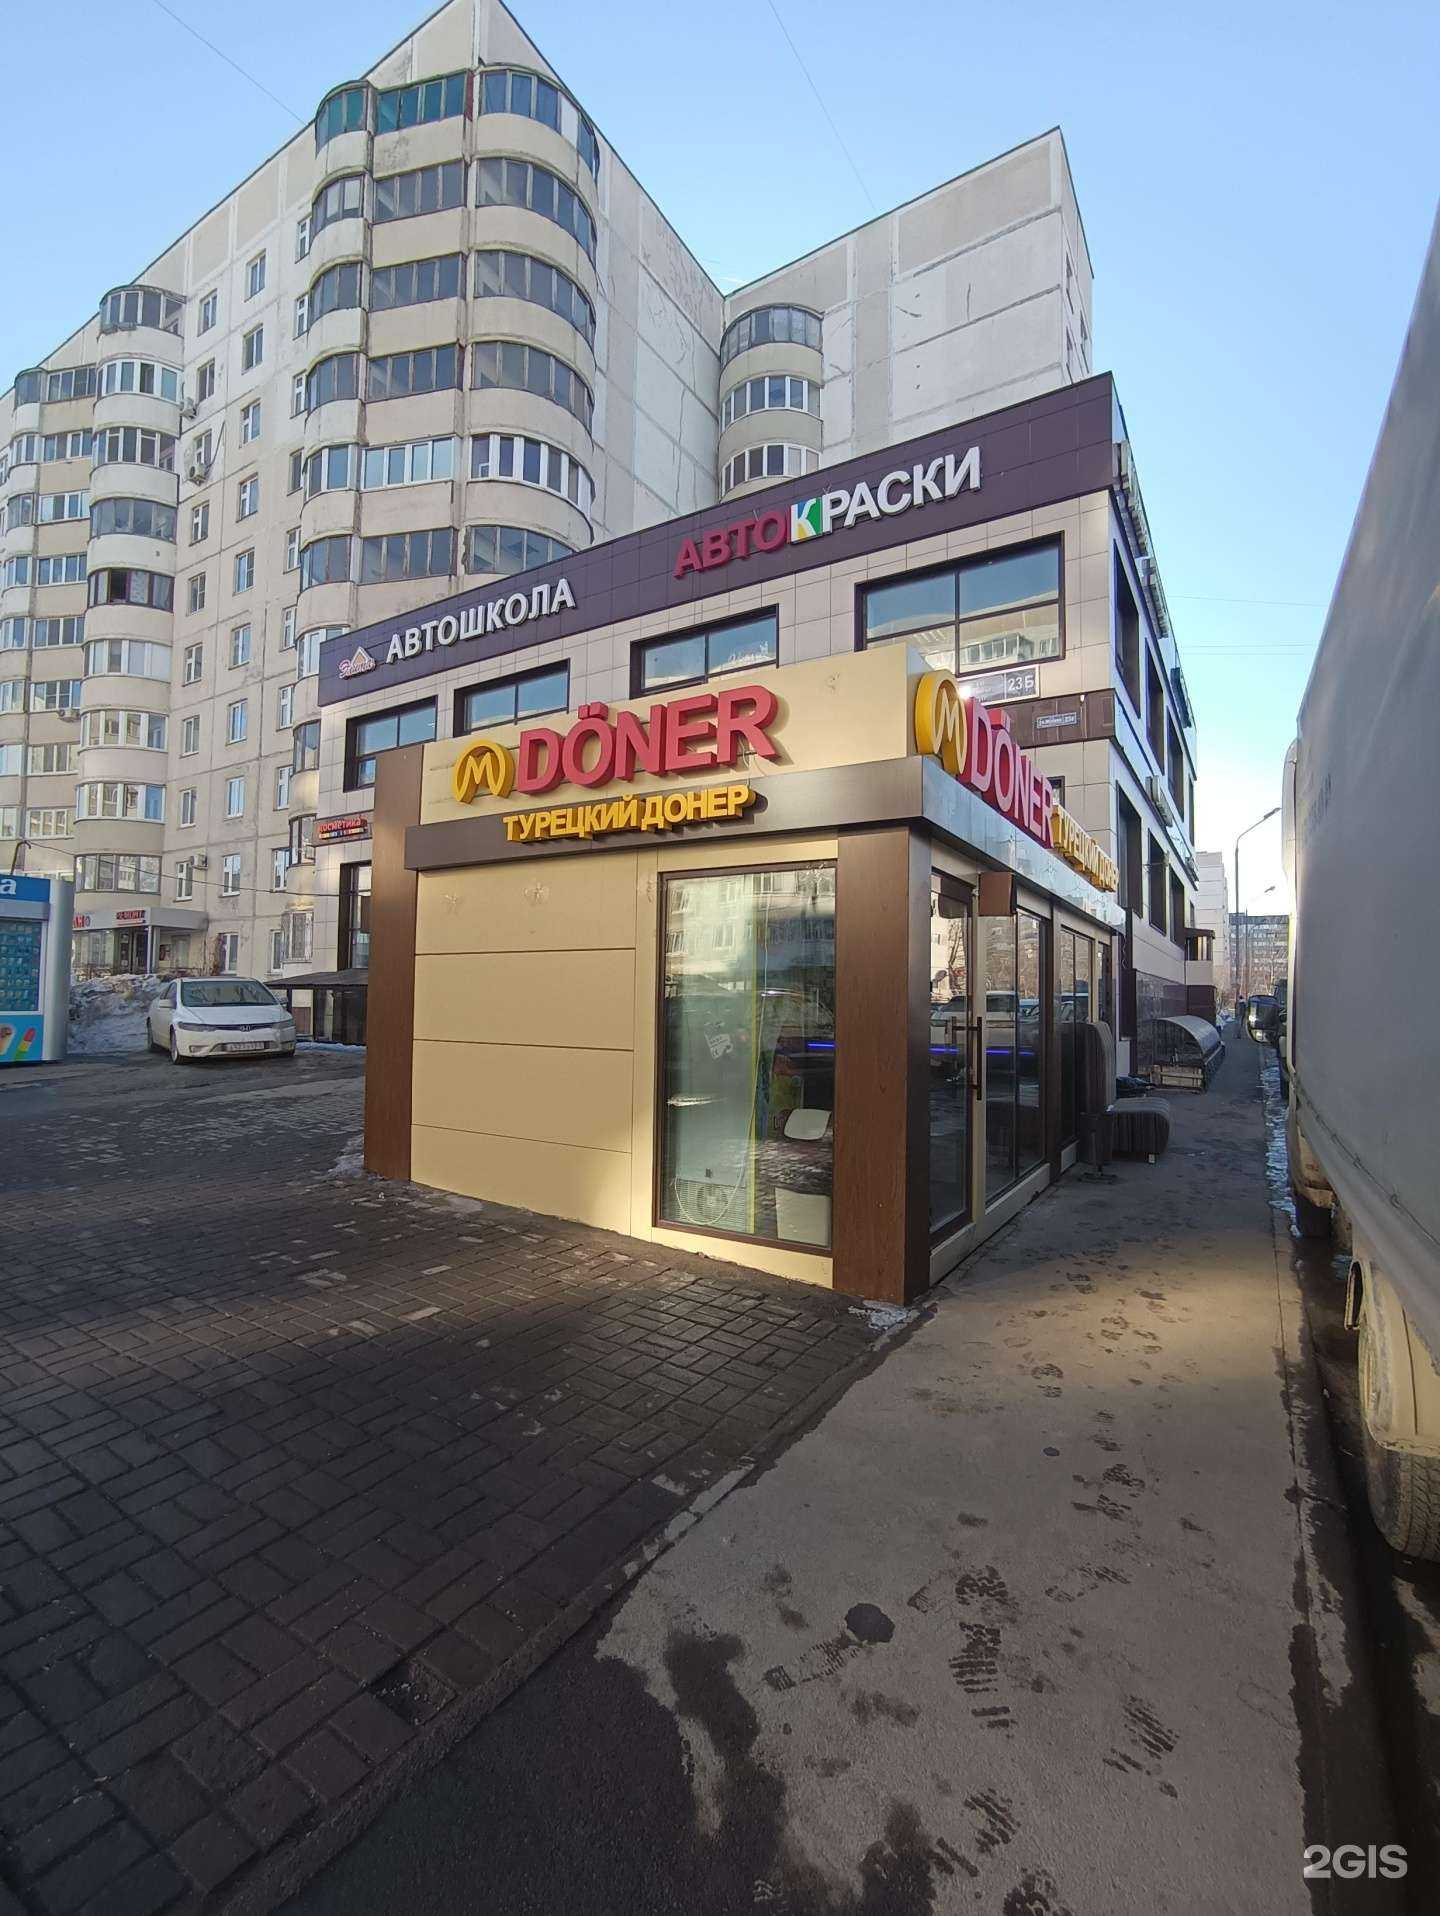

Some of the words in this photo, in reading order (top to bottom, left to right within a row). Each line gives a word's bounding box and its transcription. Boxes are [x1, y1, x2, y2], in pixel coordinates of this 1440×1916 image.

[673, 446, 981, 580] АВТОКРАСКИ
[386, 578, 577, 664] АВТОШКОЛА
[516, 684, 780, 796] DÖNER
[966, 697, 1055, 849] DÖNER
[503, 793, 639, 843] ТУРЕЦКИЙ
[641, 785, 758, 832] ДОНЕР
